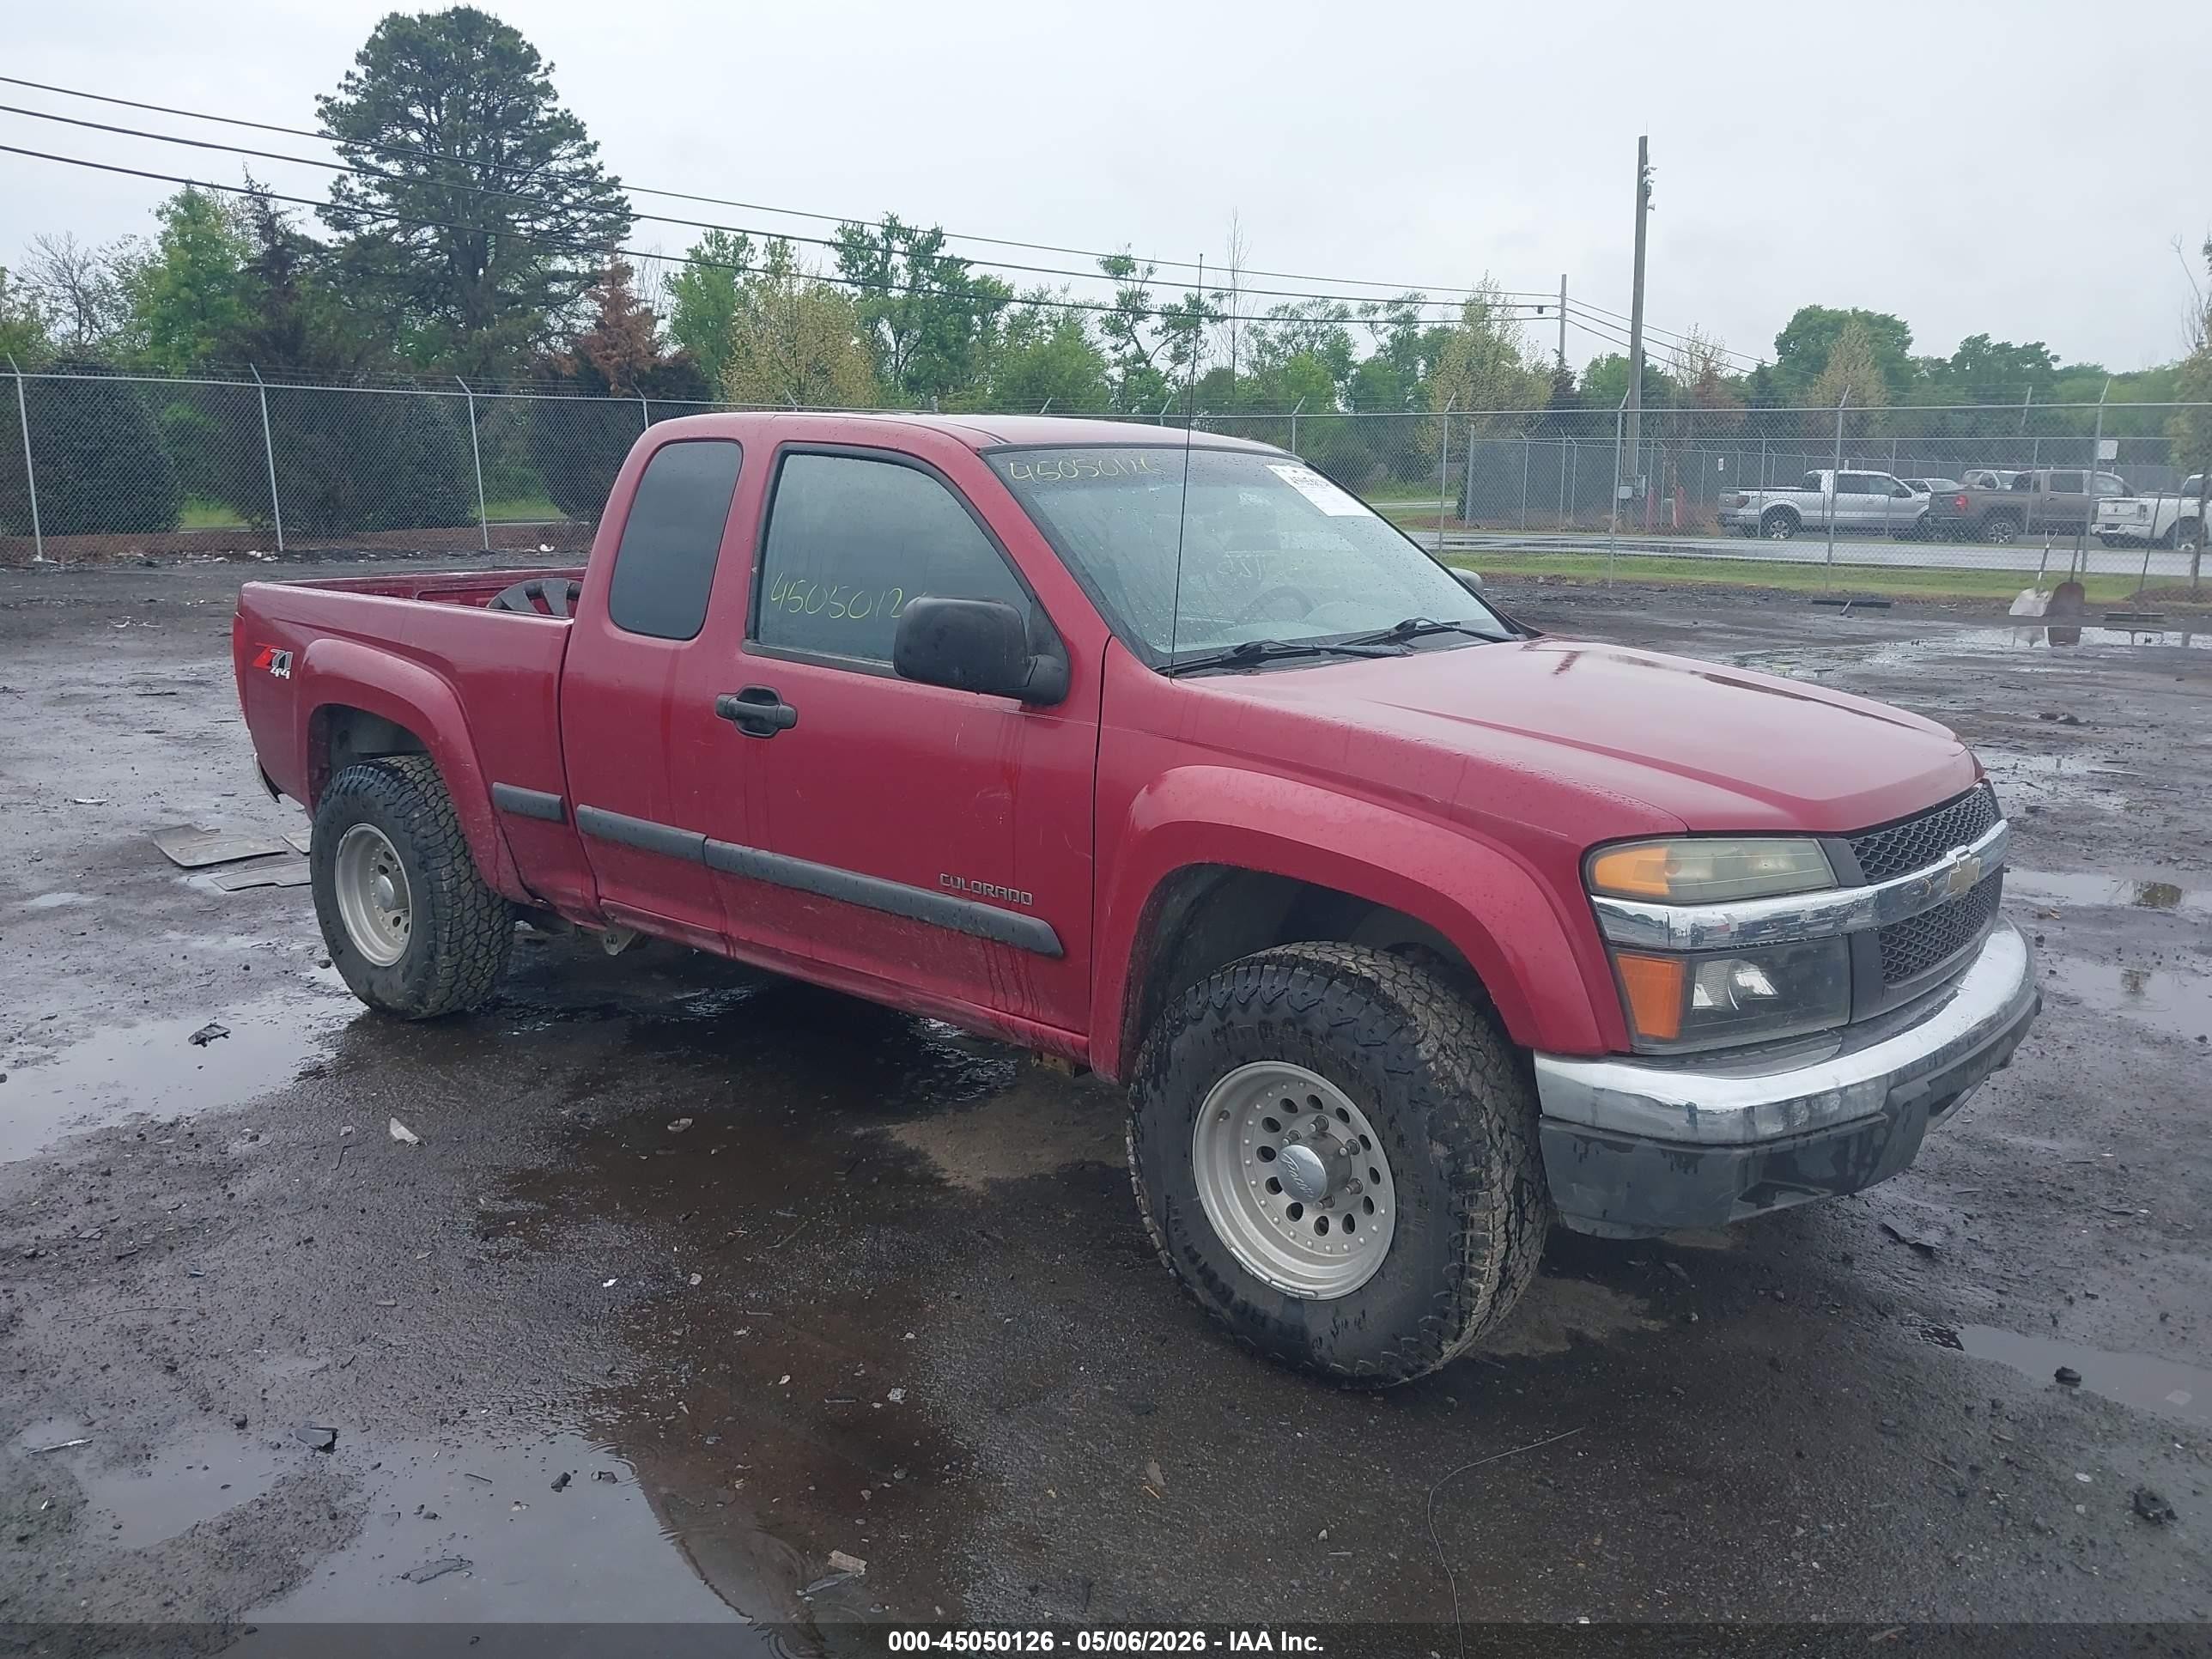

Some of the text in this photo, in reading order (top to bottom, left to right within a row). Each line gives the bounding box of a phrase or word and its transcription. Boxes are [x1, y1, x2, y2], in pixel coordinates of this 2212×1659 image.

[770, 571, 926, 623] 4505012
[252, 642, 294, 670] Z71
[939, 872, 1033, 907] COLORADO
